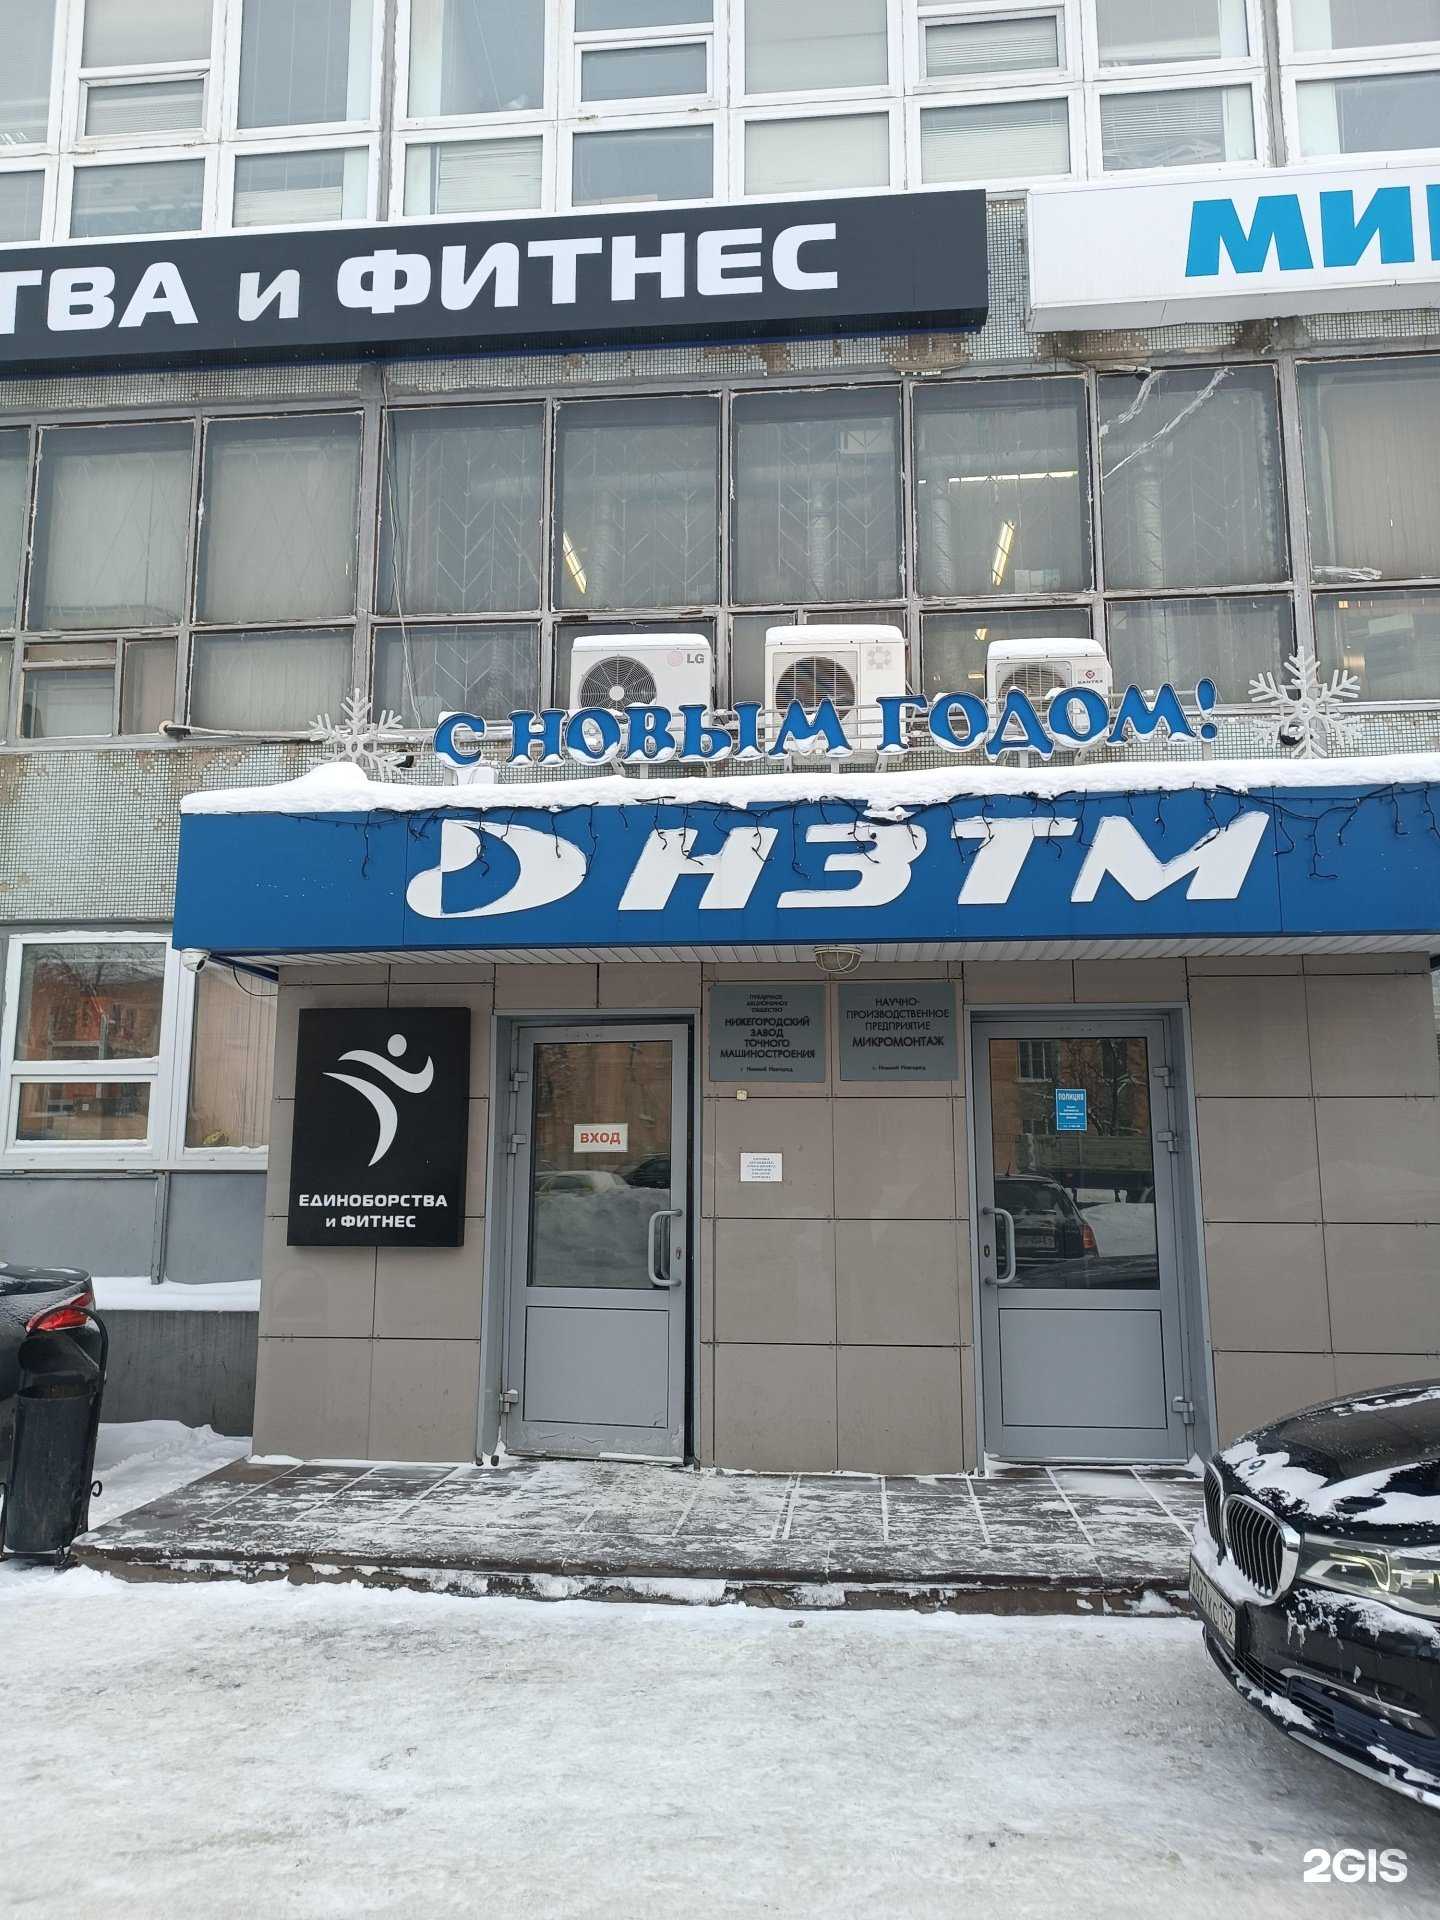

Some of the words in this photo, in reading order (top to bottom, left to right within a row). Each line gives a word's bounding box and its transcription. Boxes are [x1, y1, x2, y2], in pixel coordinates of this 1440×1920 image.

[1185, 184, 1440, 277] МИ
[238, 269, 300, 322] и
[337, 223, 839, 314] ФИТНЕС
[686, 653, 705, 664] LG
[433, 711, 487, 768] С
[506, 698, 854, 766] НОВЫМ
[876, 678, 1217, 762] ГОДОМ!
[875, 997, 920, 1006] НАУЧНО-
[846, 1009, 950, 1019] ПРОИЗВОДСТВЕННОЕ
[724, 1016, 810, 1027] НИЖЕГОРОДСКИЙ
[865, 1021, 931, 1031] ПРЕДПРИЯТИЕ
[750, 1028, 784, 1038] ЗАВОД
[744, 1039, 790, 1047] ТОЧНОГО
[852, 1036, 944, 1047] МИКРОМОНТАЖ
[720, 1049, 815, 1058] МАШИНОСТРОЕНИЯ
[579, 1132, 621, 1145] ВХОД
[298, 1194, 448, 1208] ЕДИНОБОРСТВА
[325, 1217, 336, 1228] и
[340, 1214, 417, 1229] ФИТНЕС
